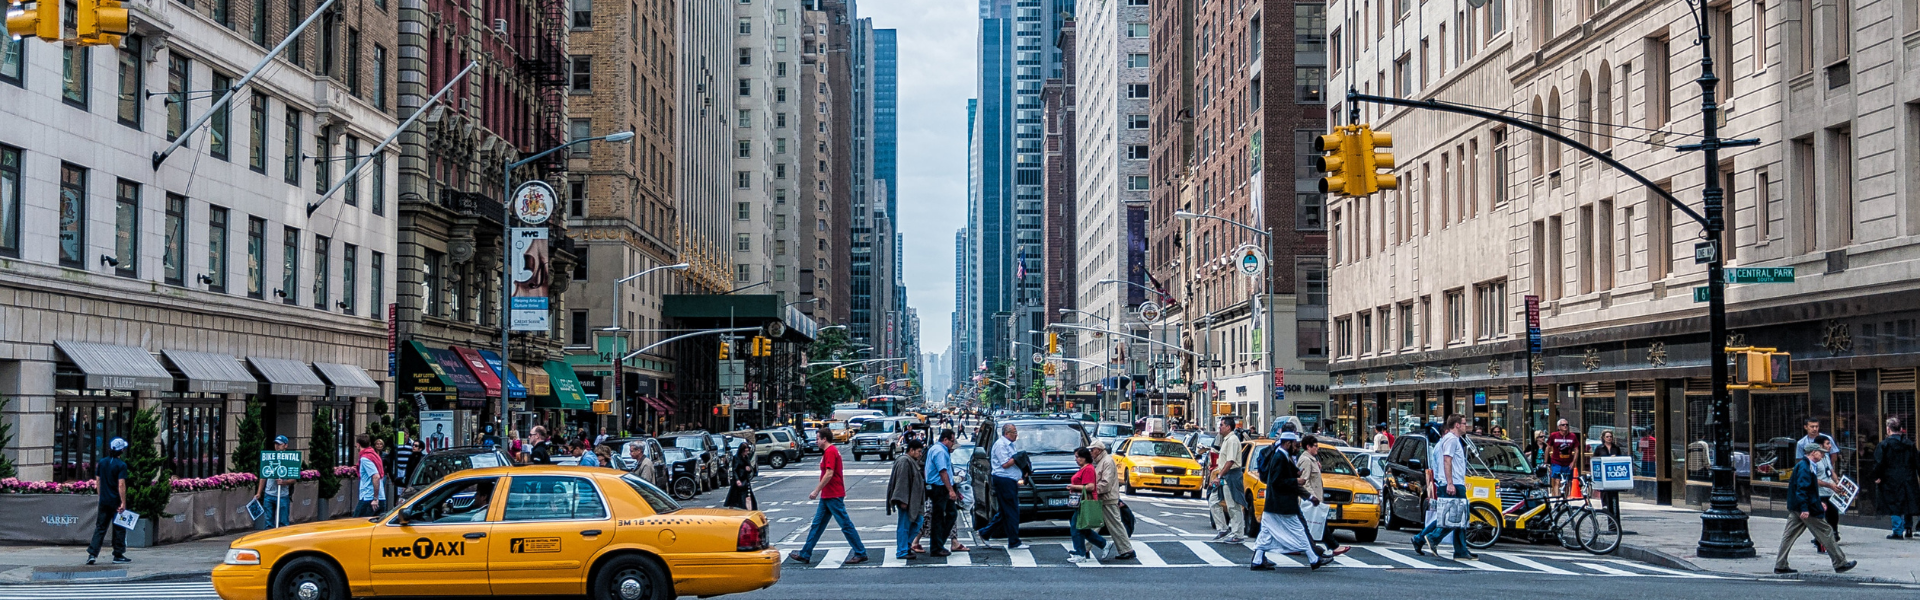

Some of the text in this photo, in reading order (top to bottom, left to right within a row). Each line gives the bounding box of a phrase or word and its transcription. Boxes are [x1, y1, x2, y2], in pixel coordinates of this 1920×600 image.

[1698, 249, 1706, 258] ONE
[1737, 269, 1793, 277] CENTRAL PARK
[102, 376, 112, 388] BLT
[113, 377, 136, 389] MARKET
[262, 453, 299, 461] BIKE RENTAL
[41, 515, 78, 524] MARKET
[382, 541, 464, 557] NYC TAXI
